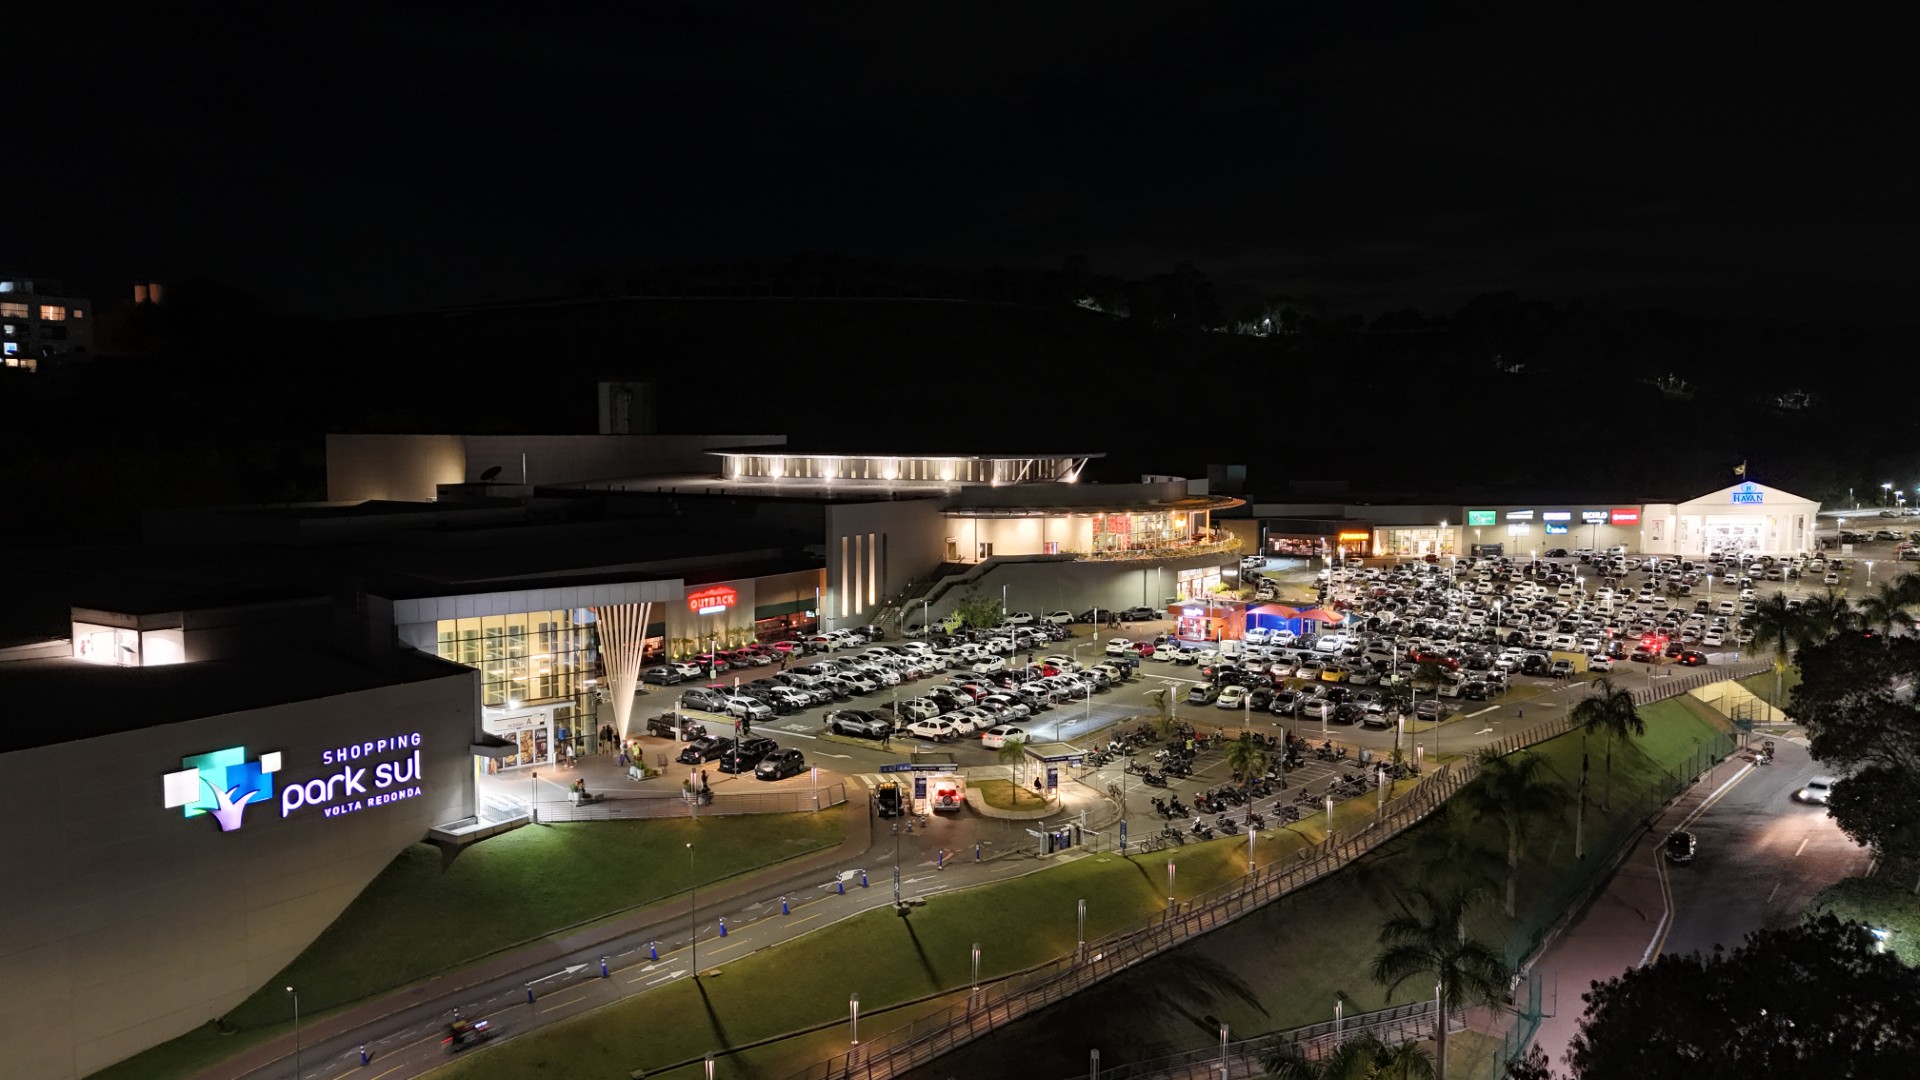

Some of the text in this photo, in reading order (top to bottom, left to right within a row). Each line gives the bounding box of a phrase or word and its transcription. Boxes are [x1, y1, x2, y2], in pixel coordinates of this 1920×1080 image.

[1733, 494, 1764, 502] HAVAN
[690, 594, 734, 609] OUTBACK
[322, 732, 422, 765] SHOPPING
[281, 749, 422, 818] park sul
[324, 786, 422, 818] VOLTA REDONDA
